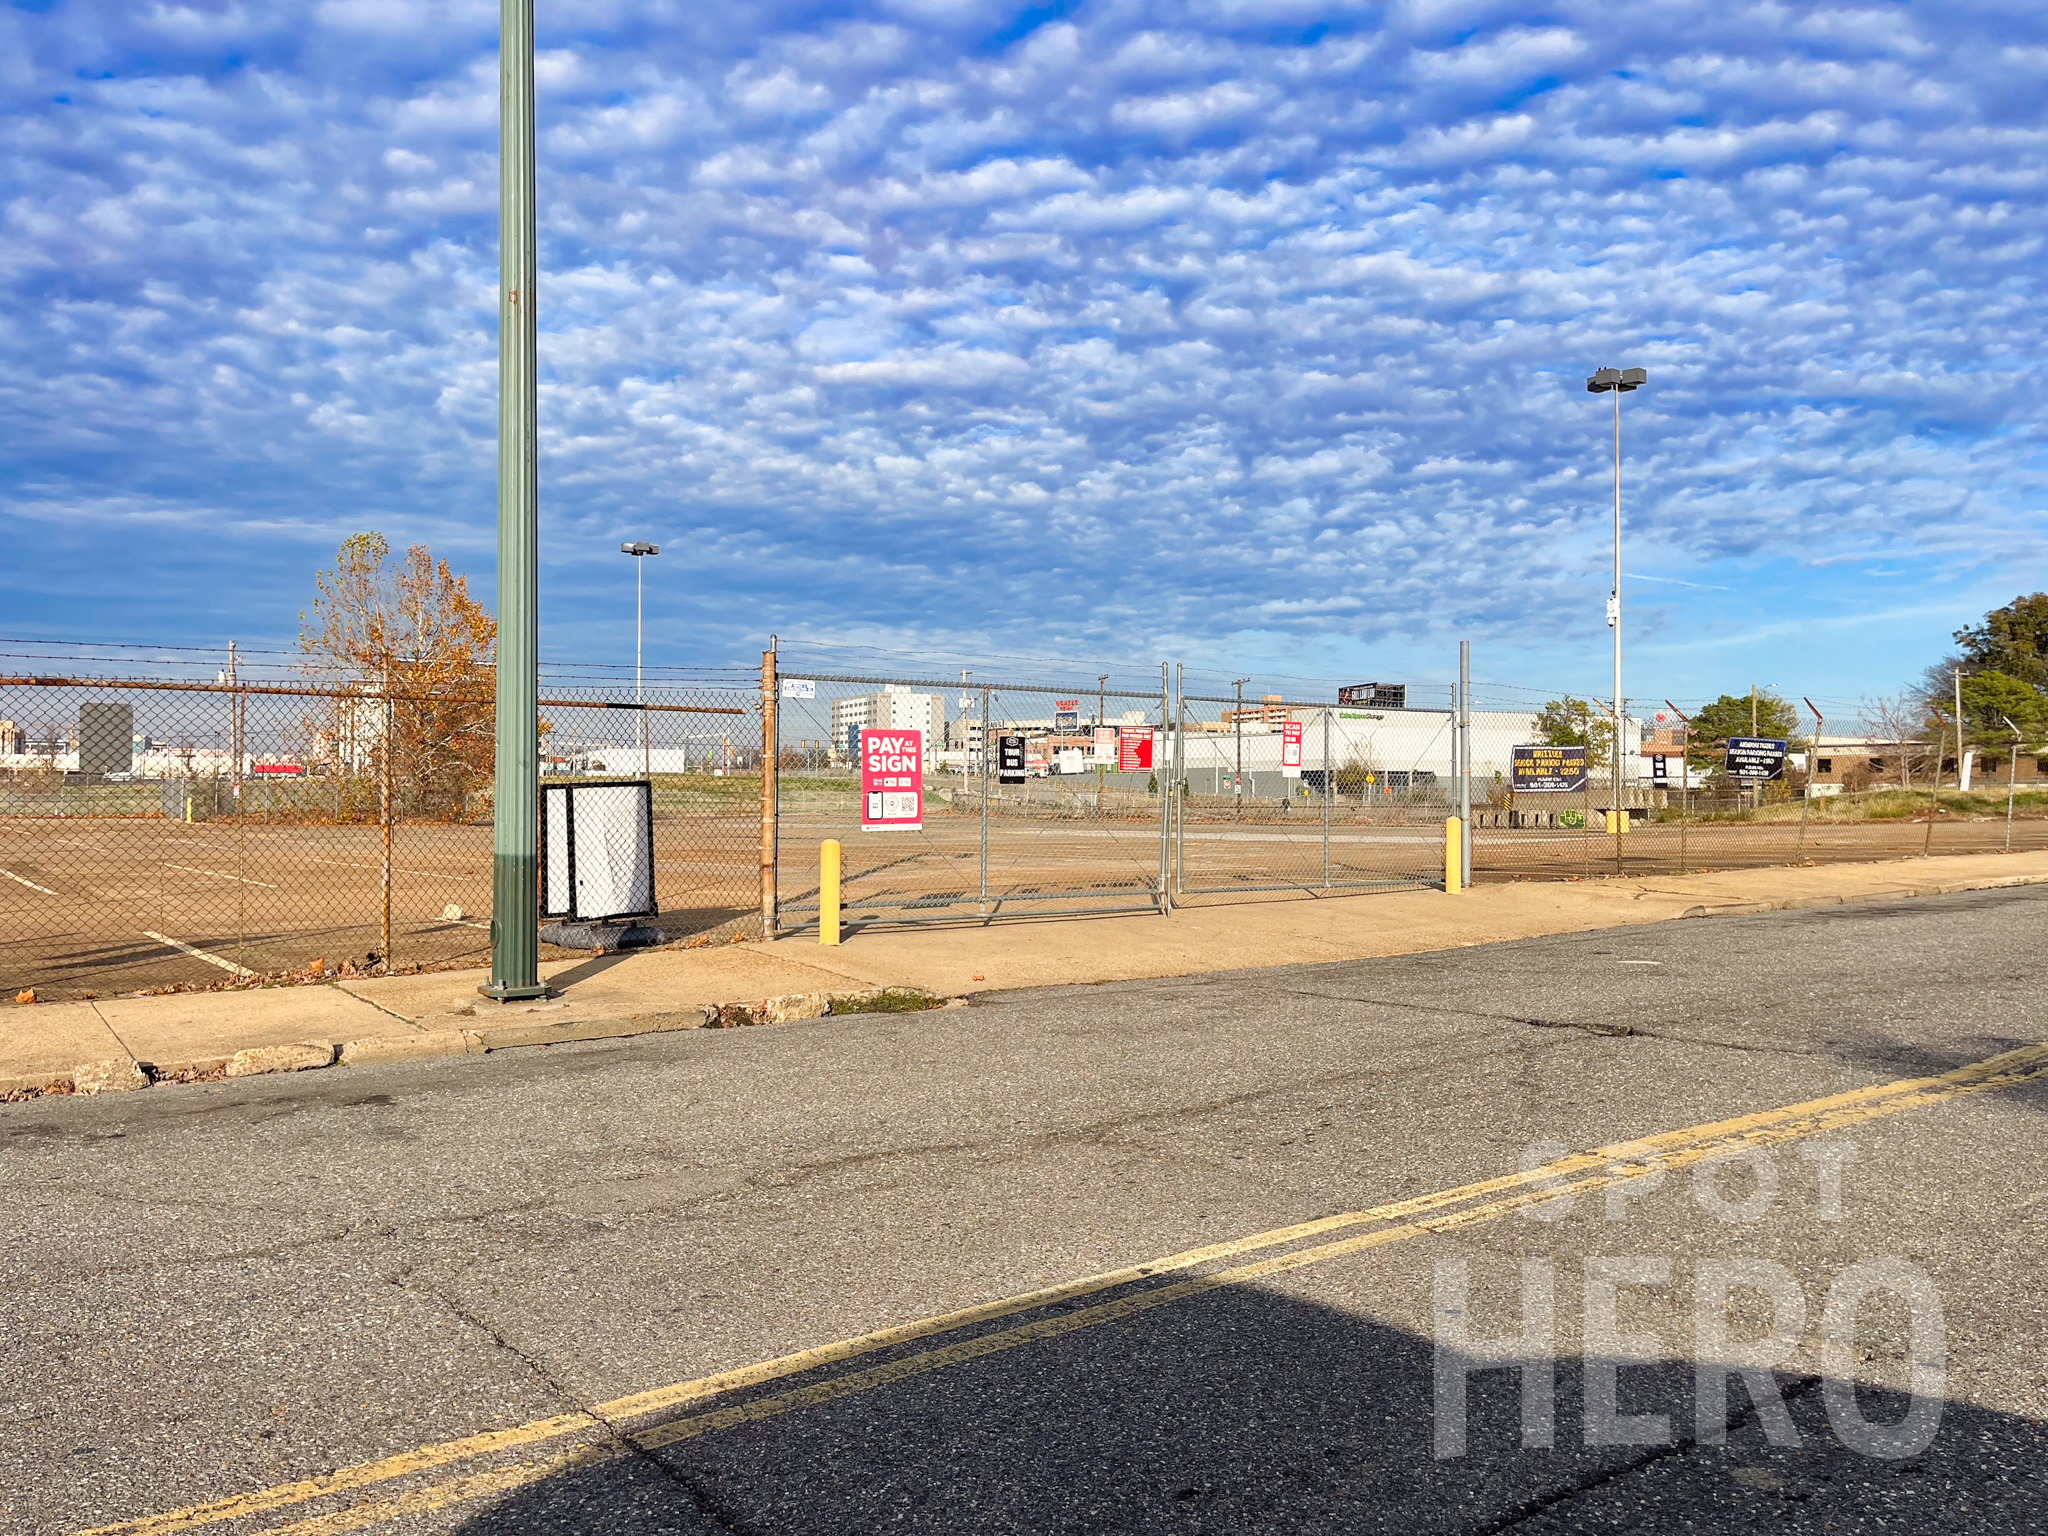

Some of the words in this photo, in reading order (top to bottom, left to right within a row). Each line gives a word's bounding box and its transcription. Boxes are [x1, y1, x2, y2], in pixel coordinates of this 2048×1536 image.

[868, 736, 905, 754] PAY
[1004, 748, 1020, 756] TOUR
[868, 755, 916, 772] SIGN
[1006, 758, 1018, 767] BUS
[1562, 759, 1584, 767] PASSES
[1000, 769, 1025, 777] PARKING
